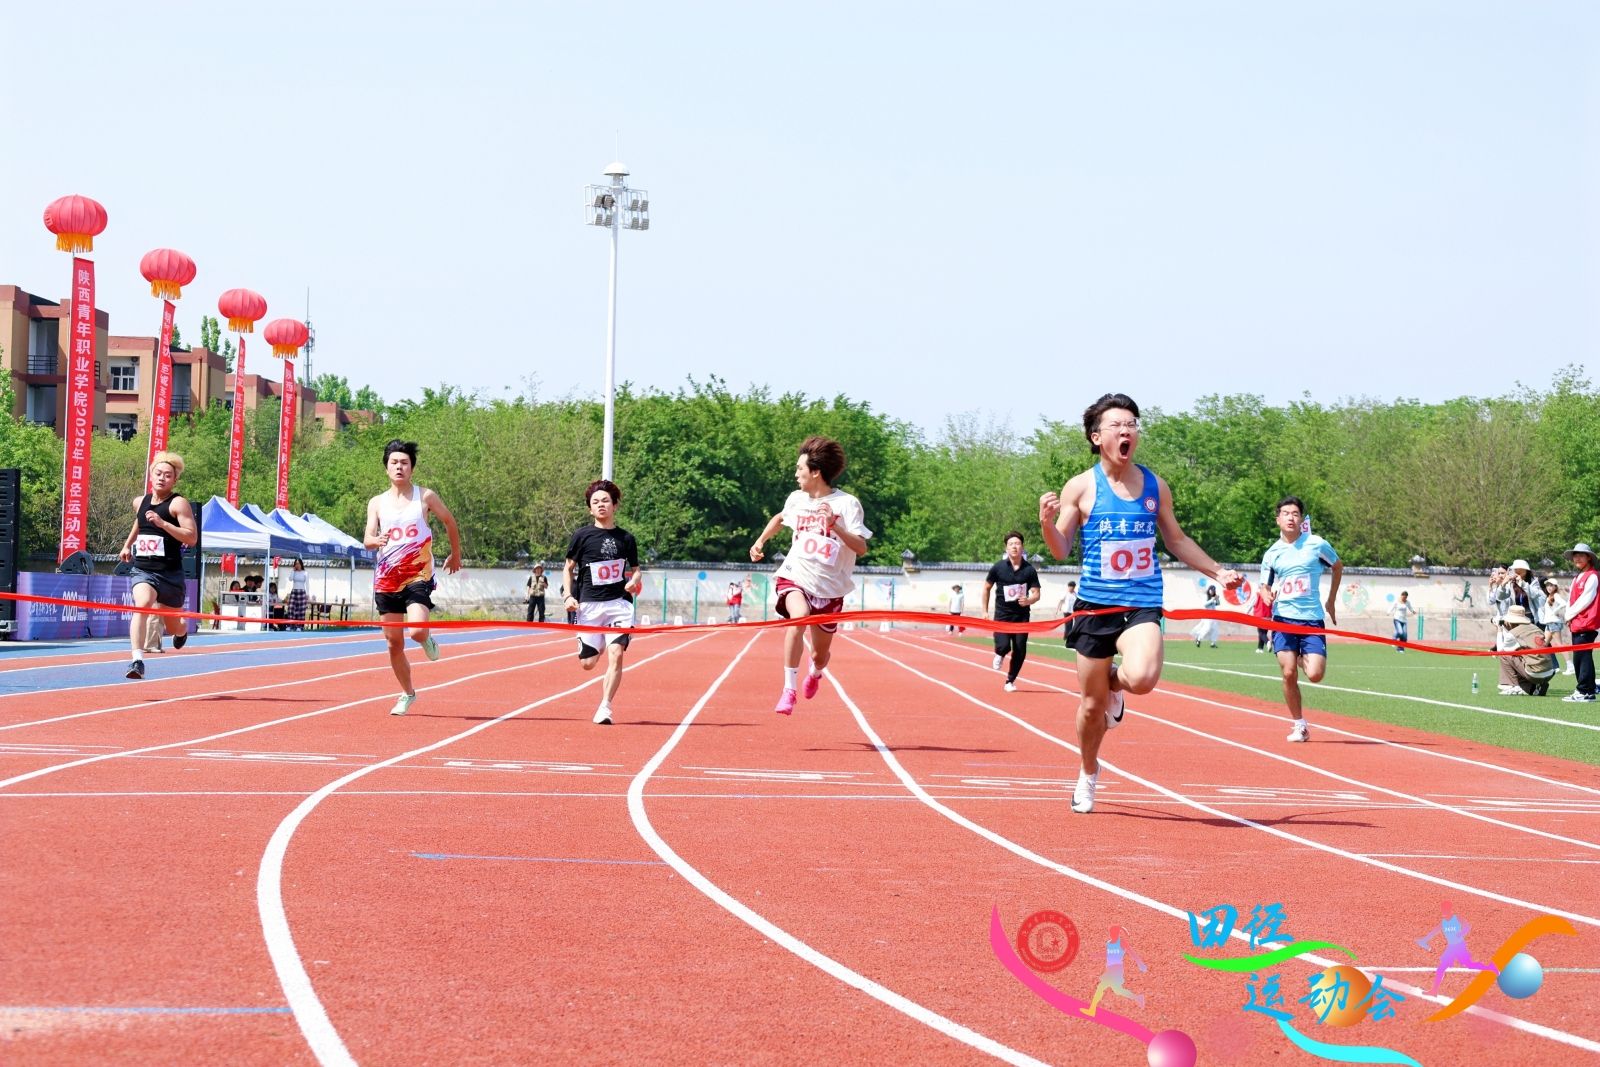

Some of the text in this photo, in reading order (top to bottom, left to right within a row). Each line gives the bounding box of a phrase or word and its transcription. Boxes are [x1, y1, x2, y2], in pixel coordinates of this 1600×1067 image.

[391, 523, 419, 541] 06
[804, 538, 832, 559] 04
[1110, 547, 1151, 572] 03
[597, 563, 620, 580] 05
